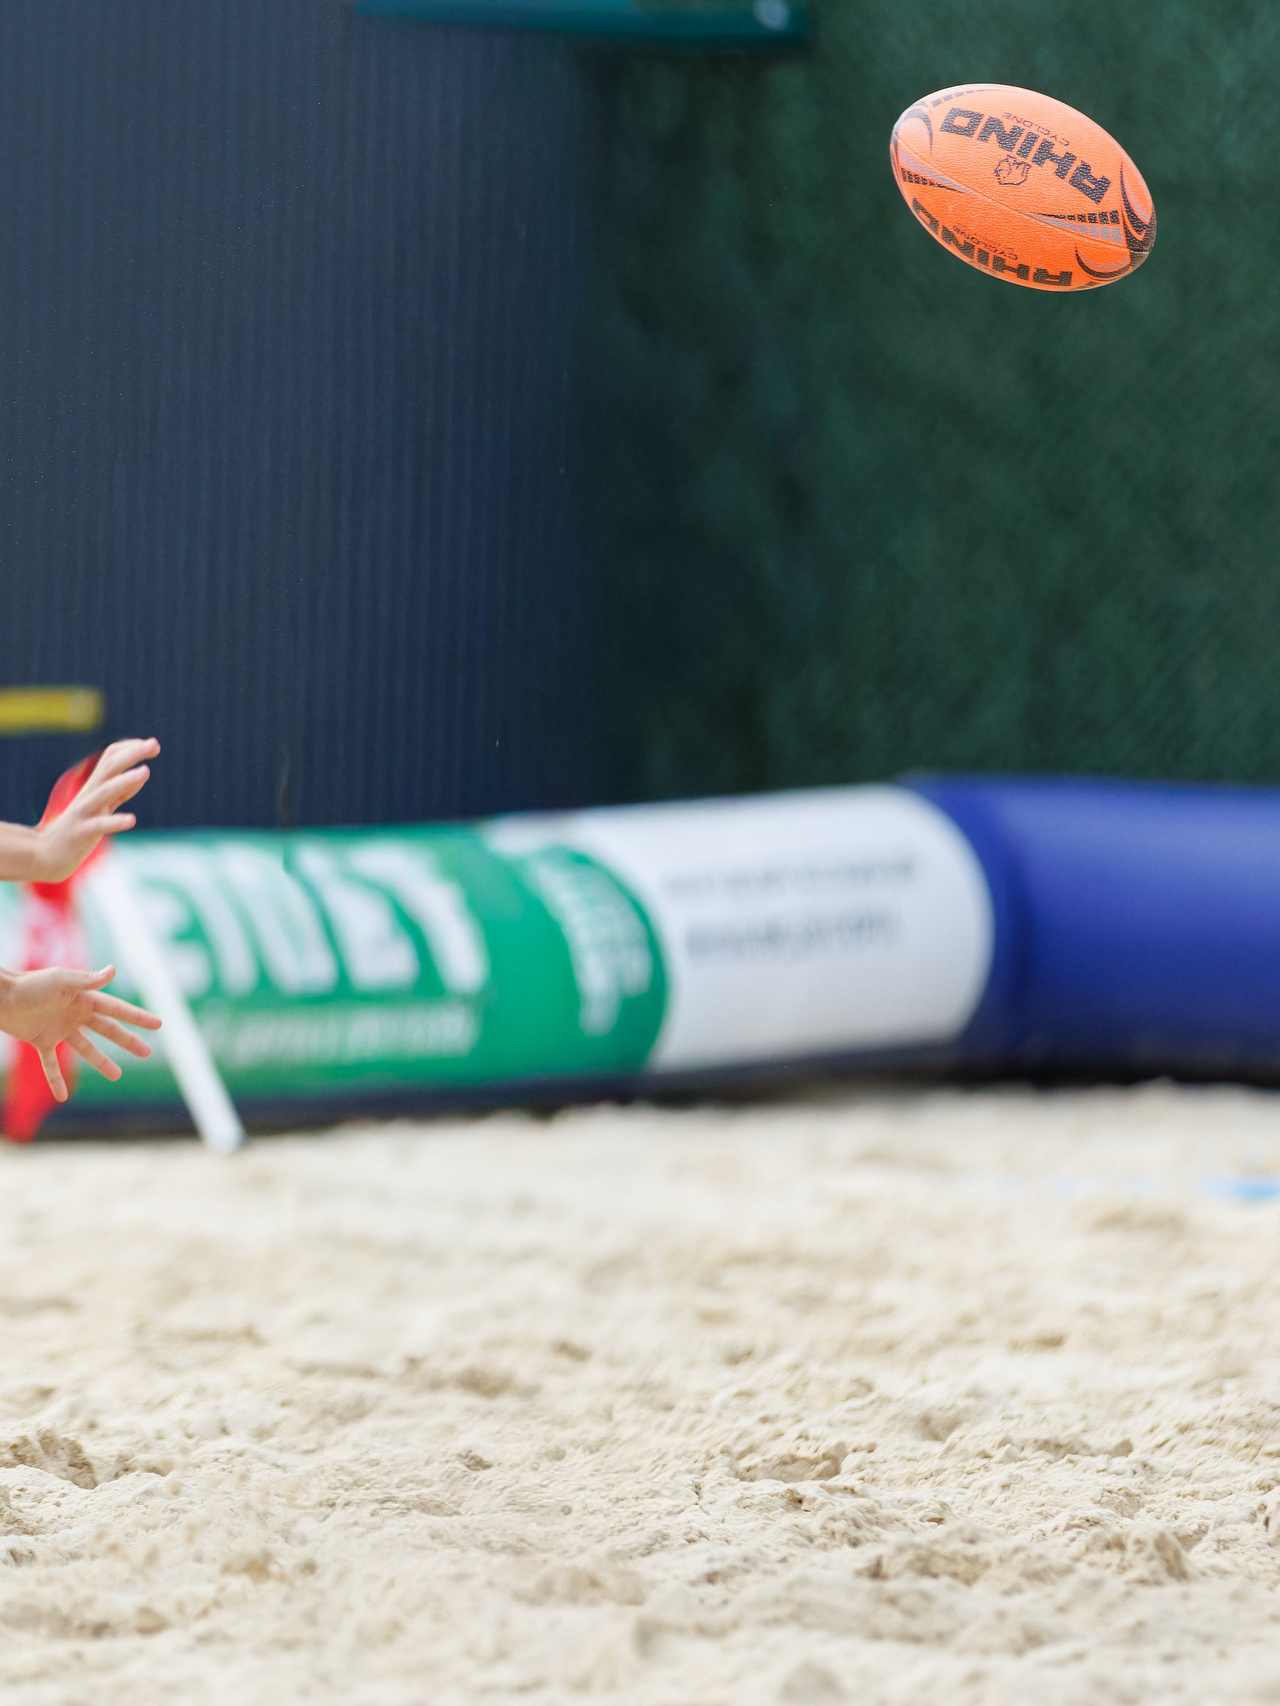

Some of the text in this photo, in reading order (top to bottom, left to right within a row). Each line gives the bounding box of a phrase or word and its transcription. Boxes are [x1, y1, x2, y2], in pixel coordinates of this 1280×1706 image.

[939, 107, 1112, 205] RHINO
[1002, 111, 1070, 147] CYCLONE
[912, 196, 1072, 286] RHINO
